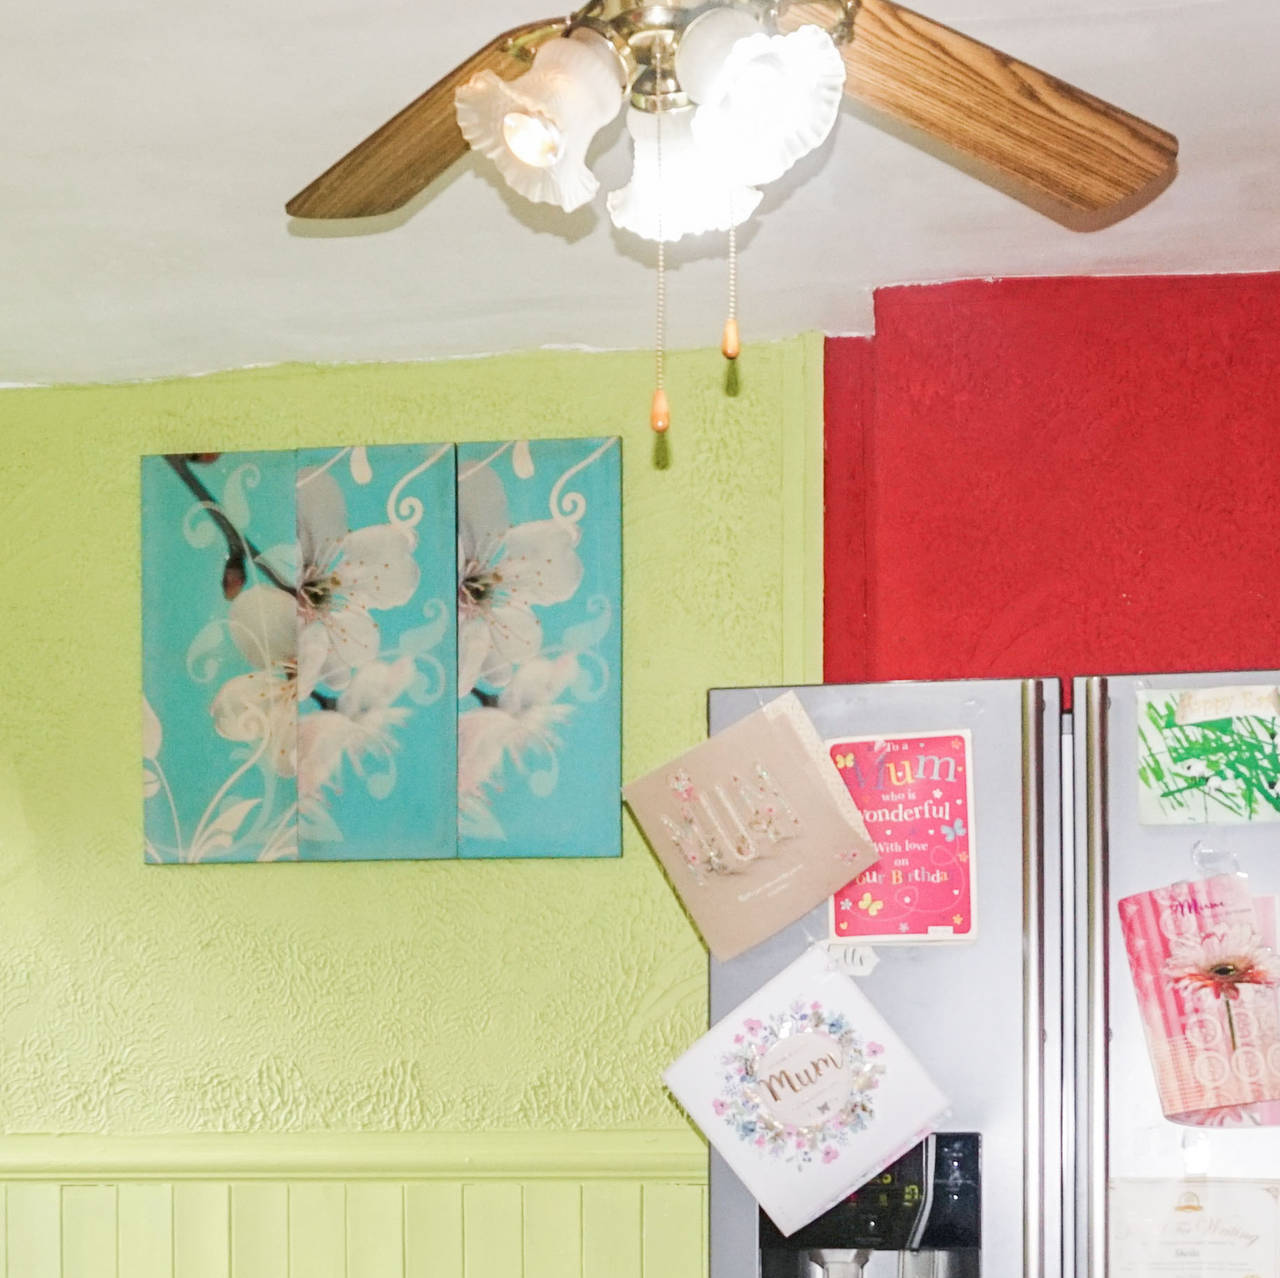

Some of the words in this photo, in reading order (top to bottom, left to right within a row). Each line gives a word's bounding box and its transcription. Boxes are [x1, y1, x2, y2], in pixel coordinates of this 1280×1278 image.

[853, 752, 957, 790] Mum
[881, 791, 905, 802] who
[907, 788, 917, 801] is
[863, 799, 950, 823] onderful
[874, 841, 902, 853] With
[905, 839, 928, 852] love
[893, 857, 910, 867] on
[758, 1050, 845, 1102] Mum
